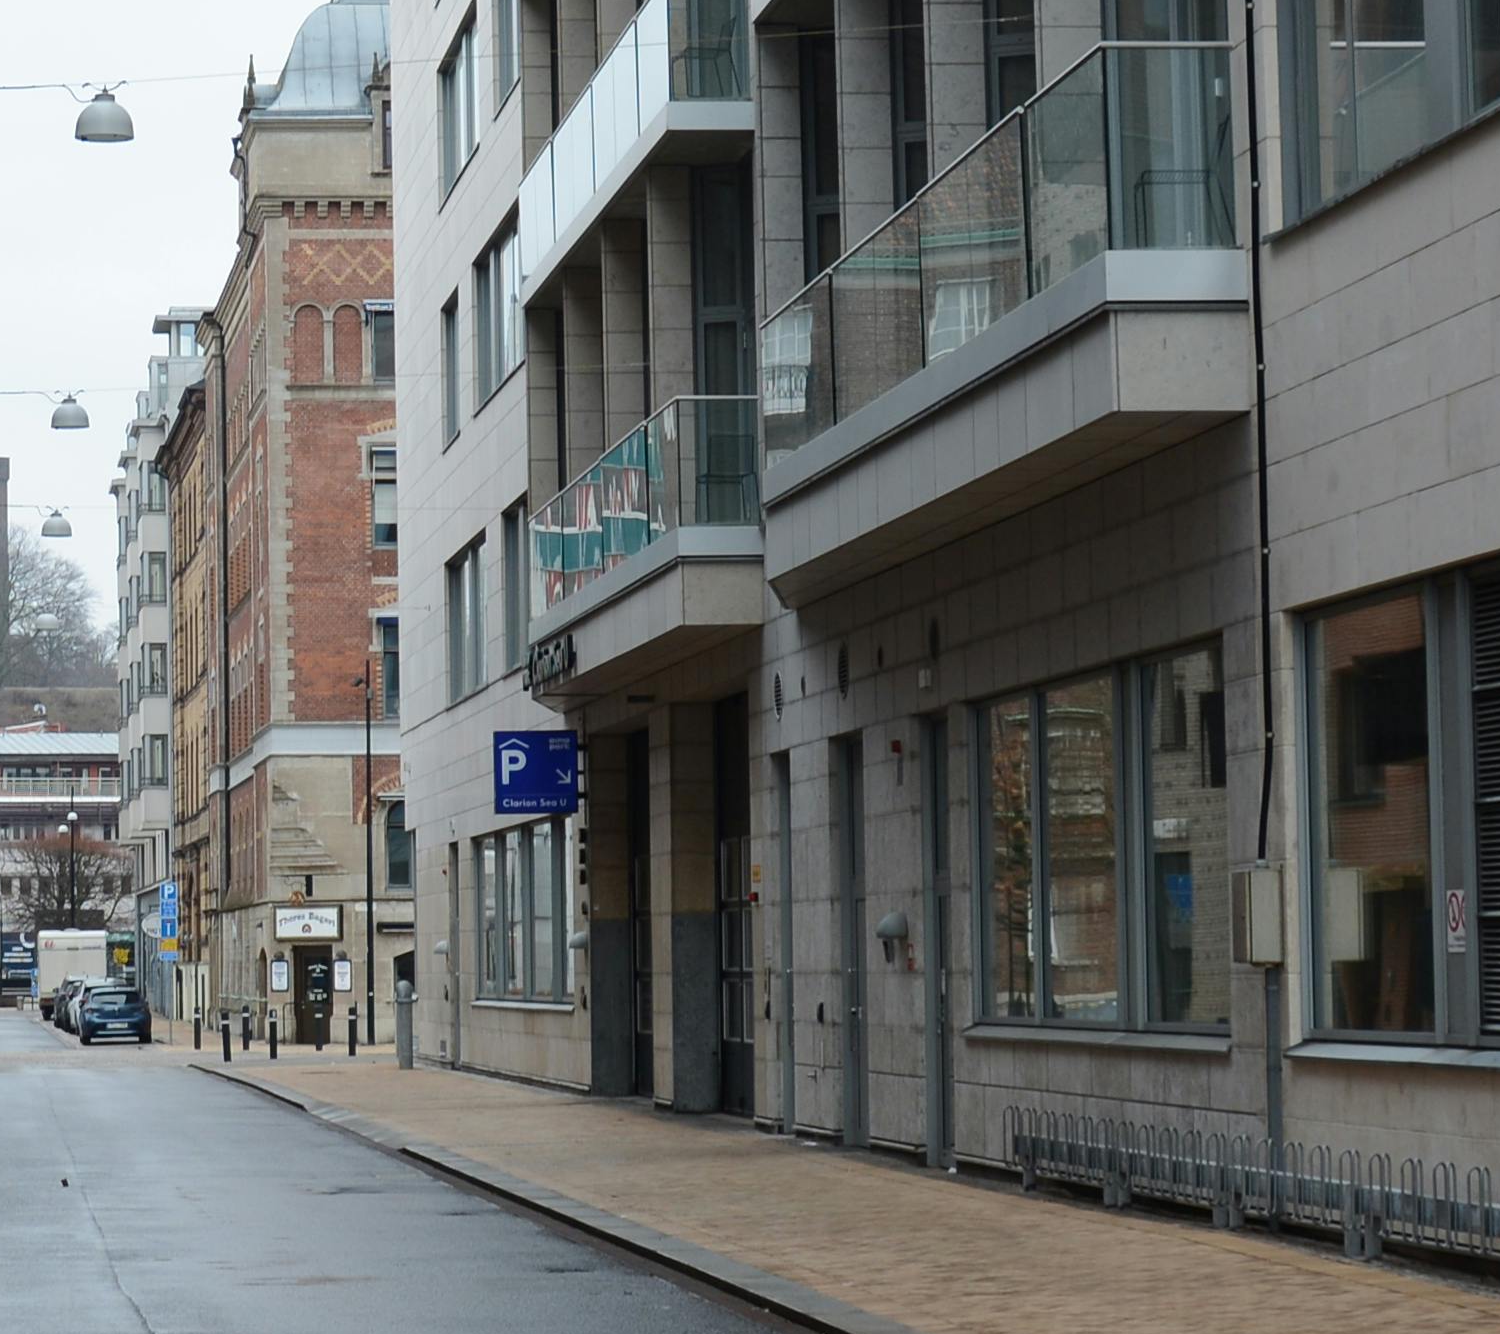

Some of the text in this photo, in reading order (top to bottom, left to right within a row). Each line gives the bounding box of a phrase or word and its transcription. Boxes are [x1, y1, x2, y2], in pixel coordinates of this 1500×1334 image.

[502, 750, 526, 785] P
[503, 798, 567, 807] Clarion Sea U
[164, 885, 174, 899] P
